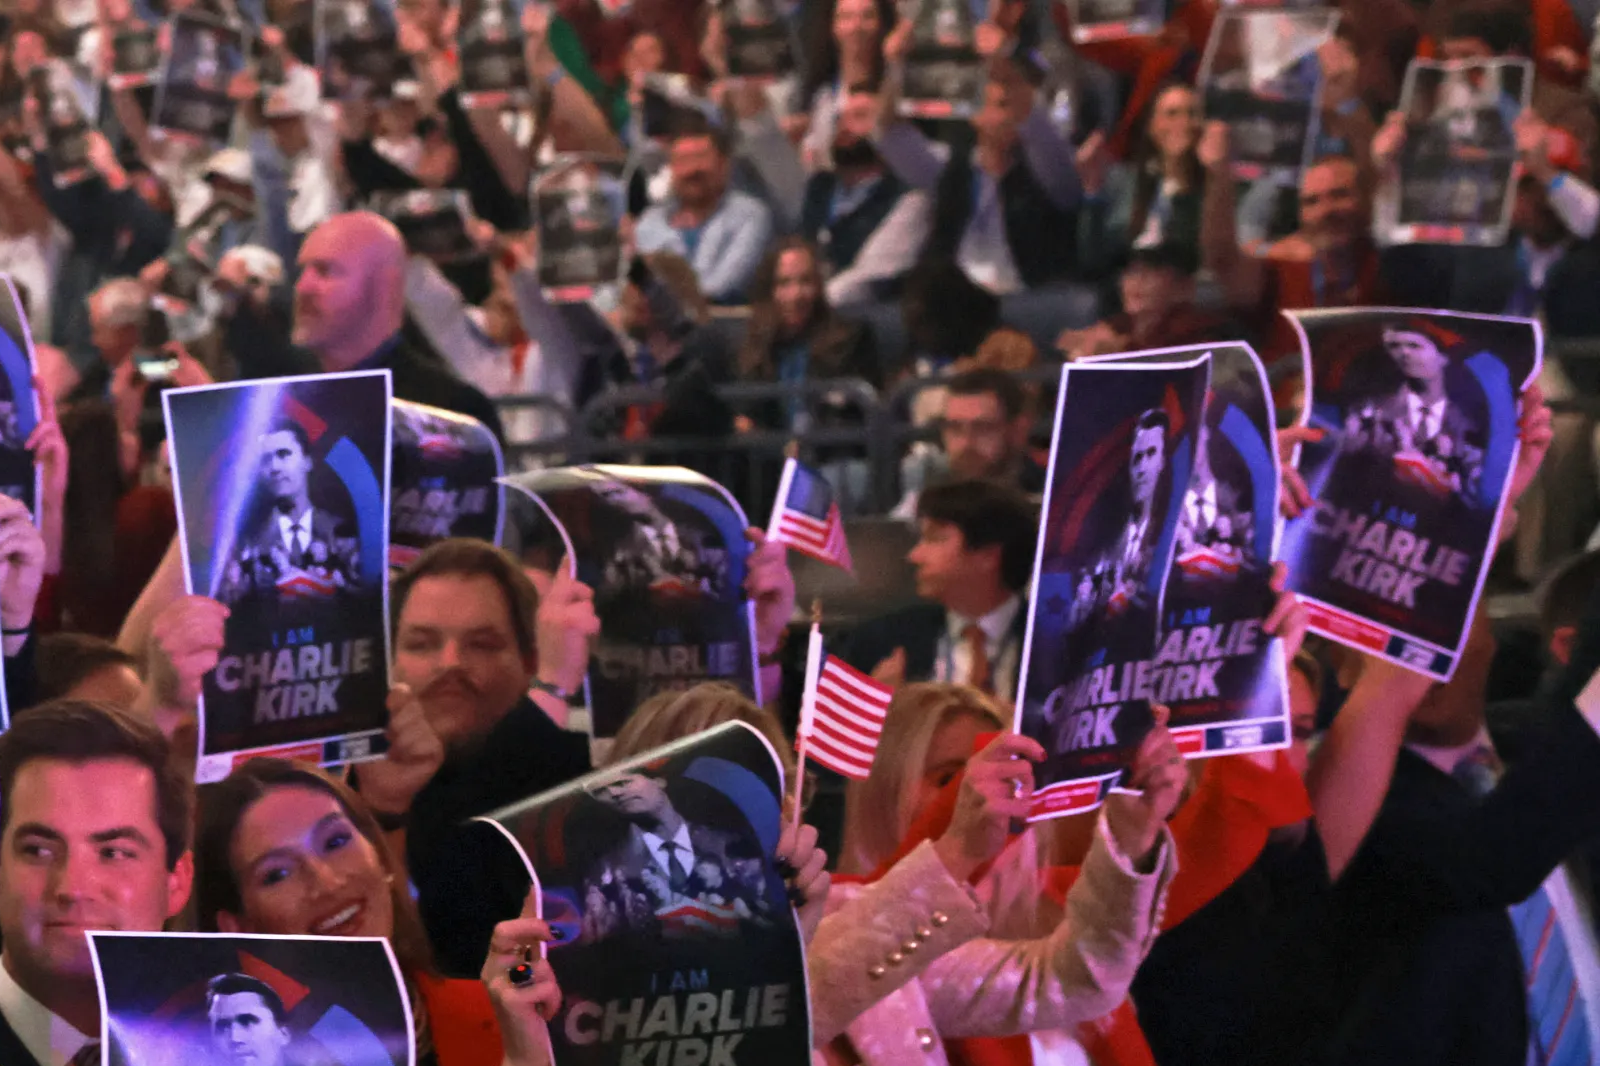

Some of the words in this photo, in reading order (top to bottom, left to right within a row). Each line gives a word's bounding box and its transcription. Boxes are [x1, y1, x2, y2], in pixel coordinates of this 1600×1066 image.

[1331, 549, 1428, 609] KIRK
[215, 637, 373, 692] CHARLIE
[254, 678, 343, 724] KIRK
[669, 968, 709, 991] AM
[564, 982, 791, 1046] CHARLIE
